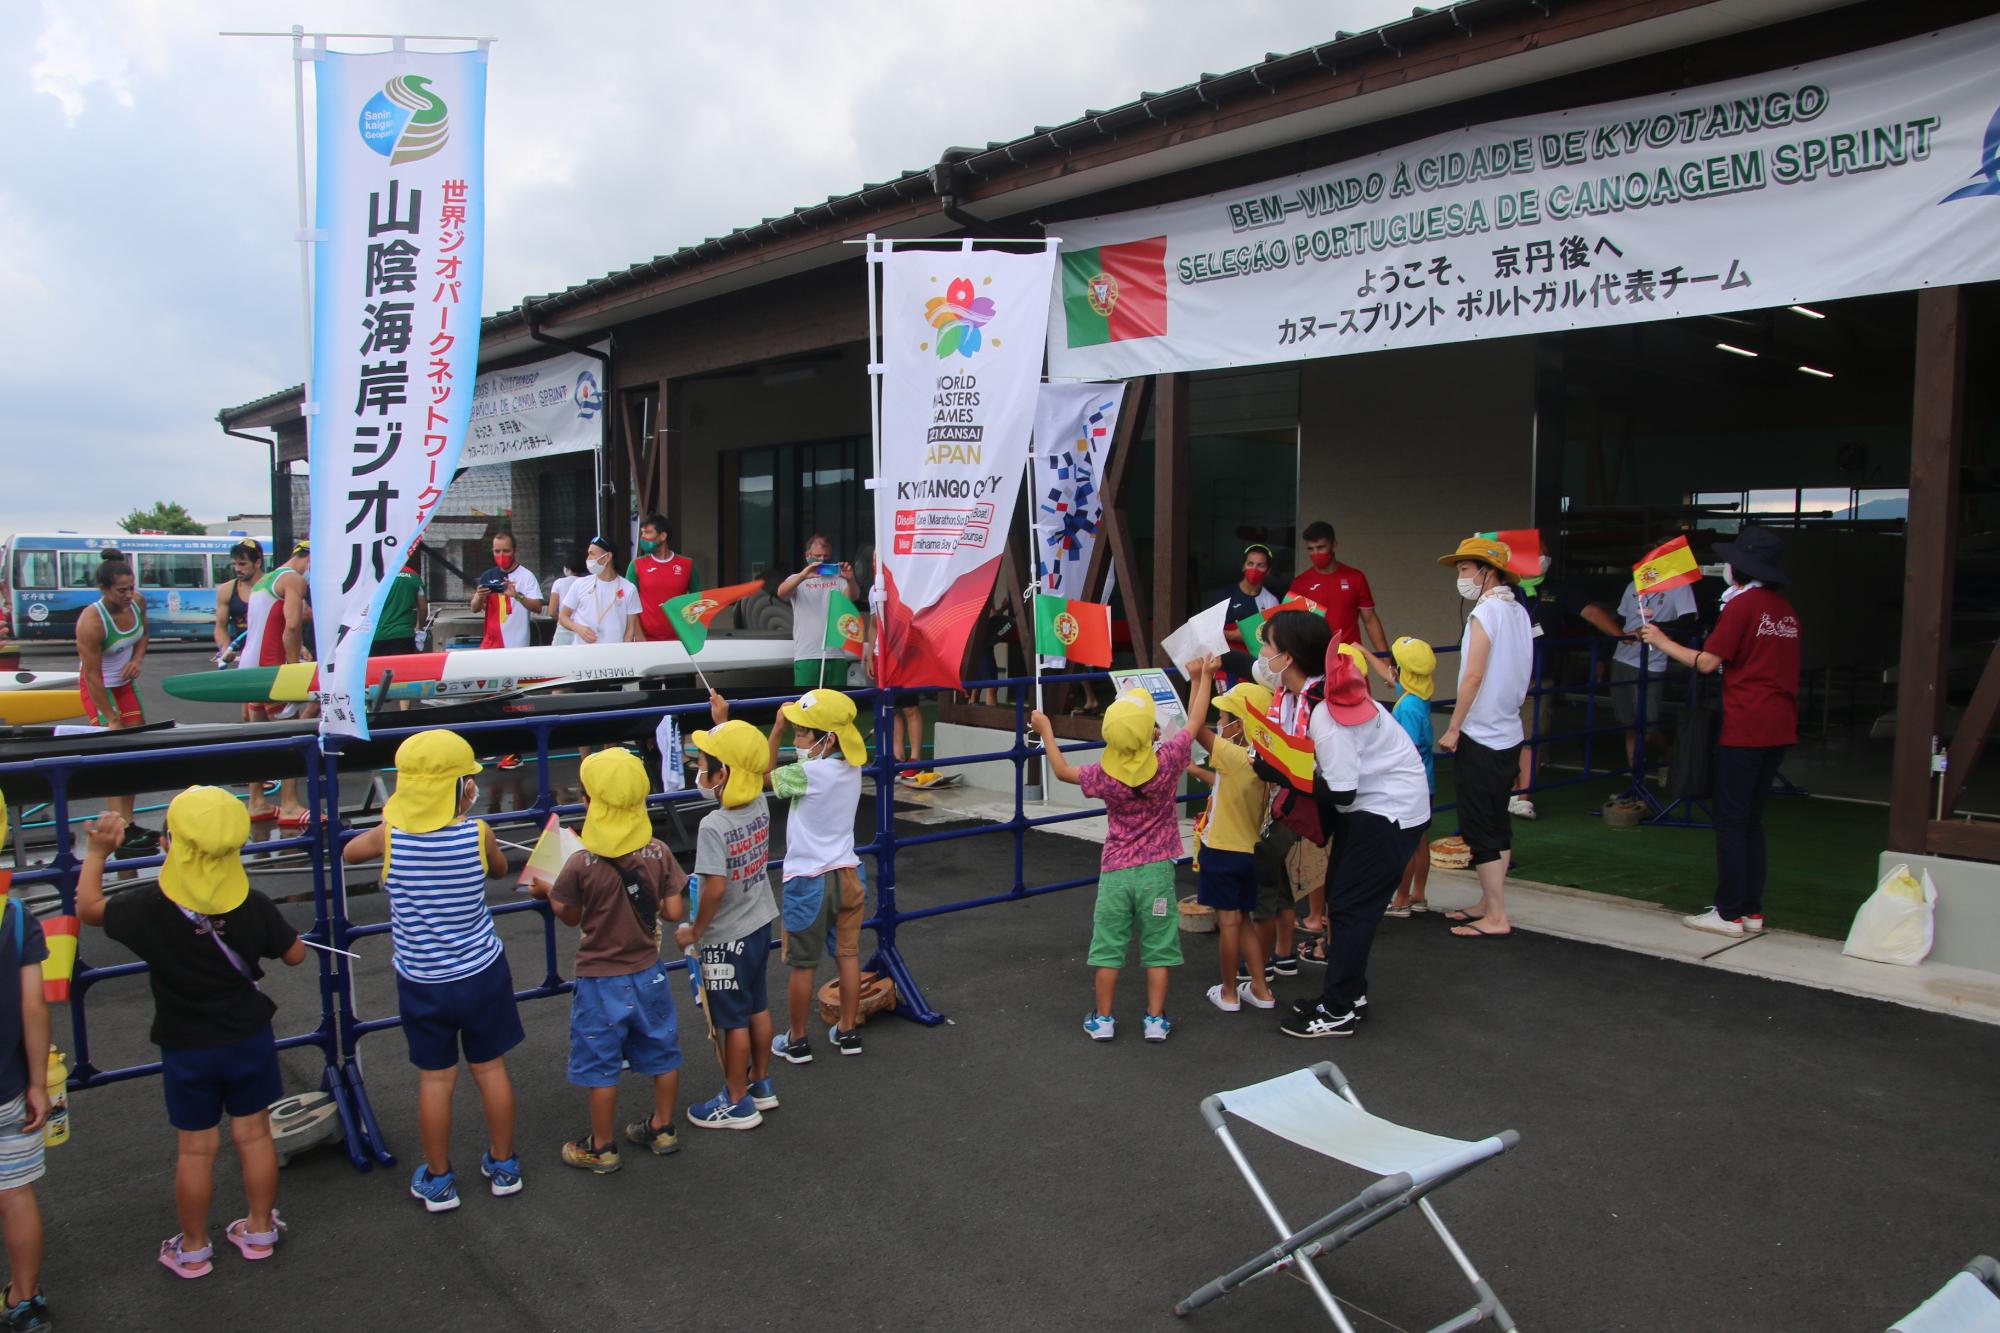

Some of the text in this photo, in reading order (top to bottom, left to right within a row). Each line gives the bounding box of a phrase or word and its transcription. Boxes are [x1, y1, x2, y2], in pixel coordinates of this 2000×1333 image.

[1417, 135, 1534, 189] CIDADE
[1541, 129, 1587, 166] DE
[1595, 83, 1828, 156] KYOTANGO
[1178, 116, 1938, 282] SELEÇÃO PORTUGUESA DE CANOAGEM SPRINT
[934, 408, 974, 424] AMES
[940, 428, 981, 440] KANSAI
[924, 443, 982, 466] APAN
